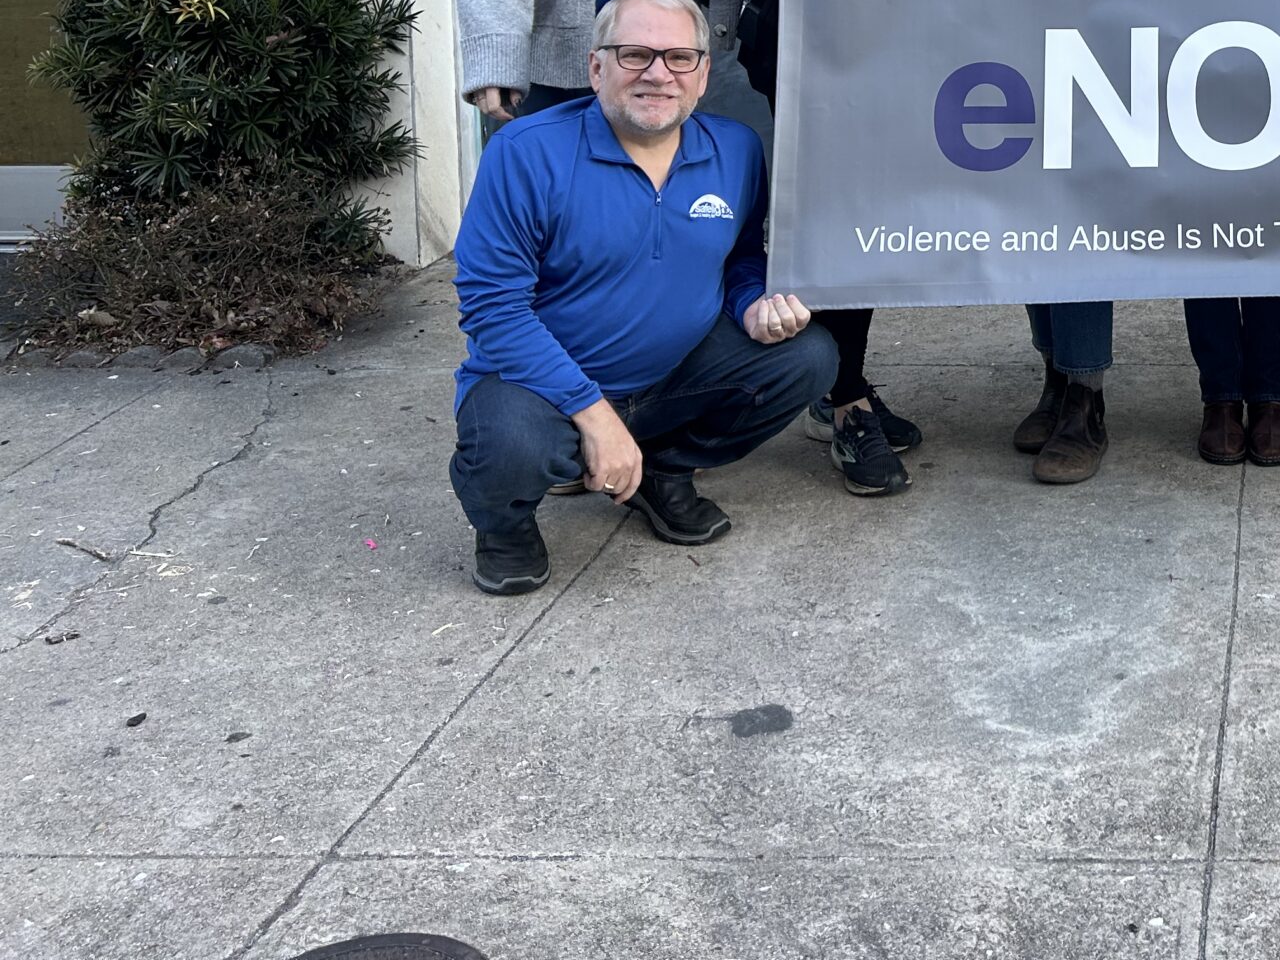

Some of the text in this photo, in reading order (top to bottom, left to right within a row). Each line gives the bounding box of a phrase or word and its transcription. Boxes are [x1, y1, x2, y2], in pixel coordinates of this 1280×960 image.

[855, 225, 991, 253] Violence
[1001, 224, 1058, 252] and
[1068, 224, 1165, 251] Abuse
[1176, 224, 1202, 249] Is
[1212, 223, 1265, 248] Not
